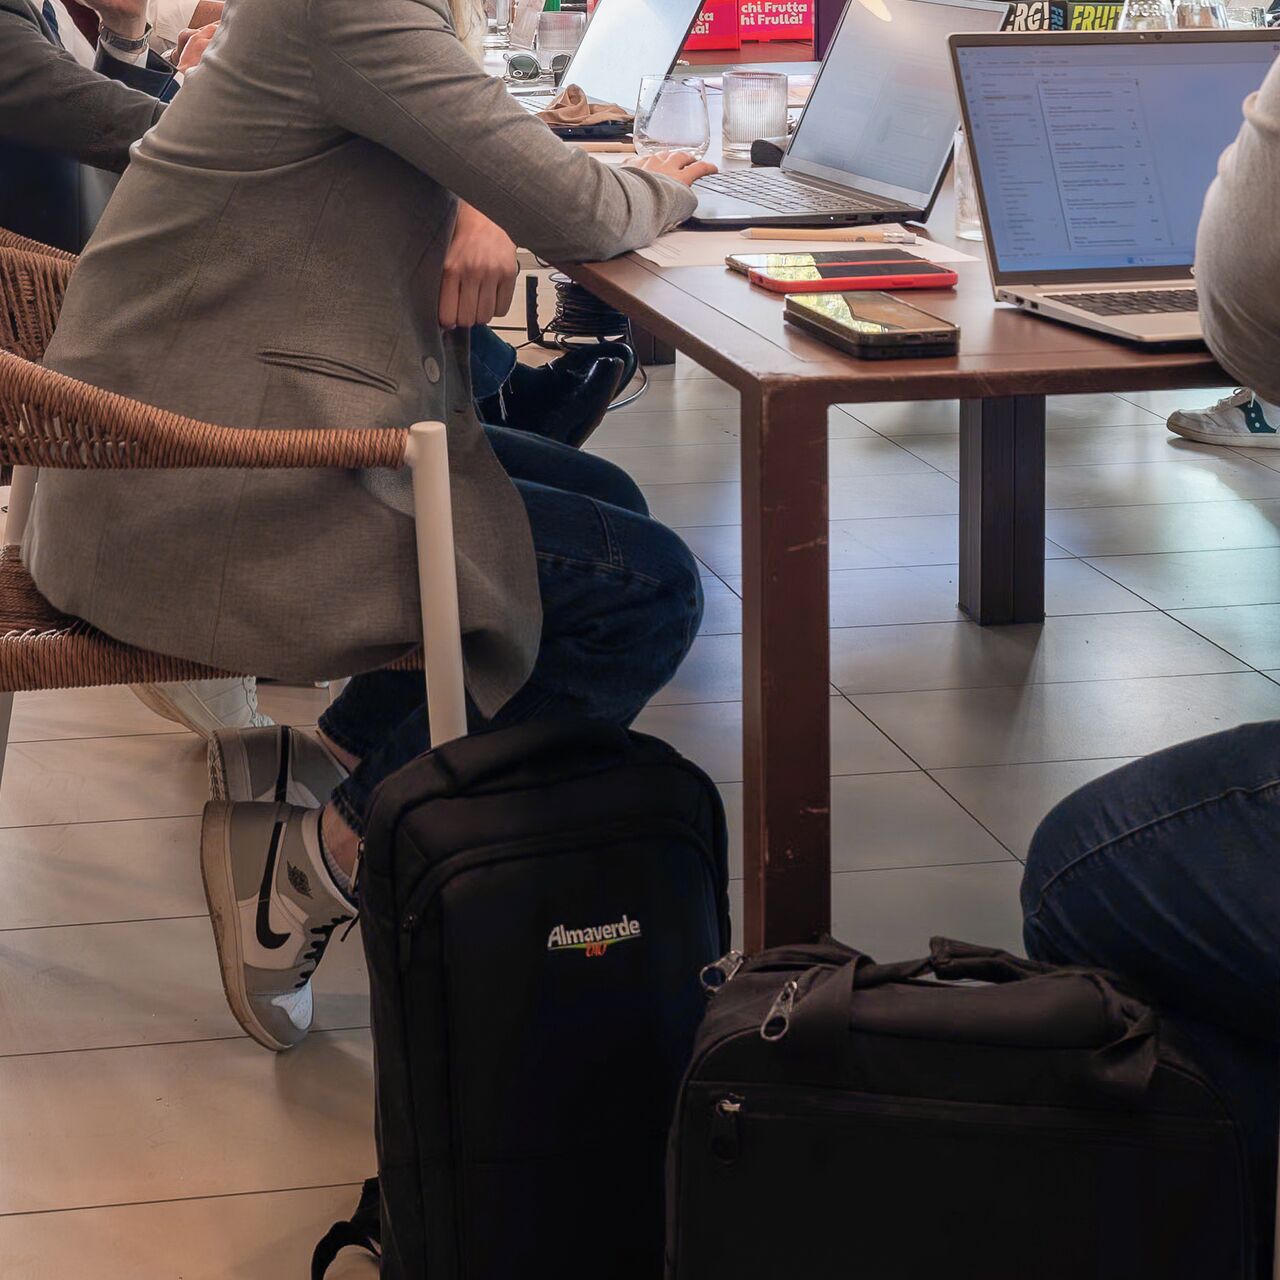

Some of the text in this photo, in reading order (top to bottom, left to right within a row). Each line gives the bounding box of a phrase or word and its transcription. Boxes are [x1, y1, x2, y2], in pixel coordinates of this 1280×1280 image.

[741, 1, 808, 13] chi Frutta
[741, 11, 804, 25] hi Frullà!
[546, 914, 641, 949] Almaverde
